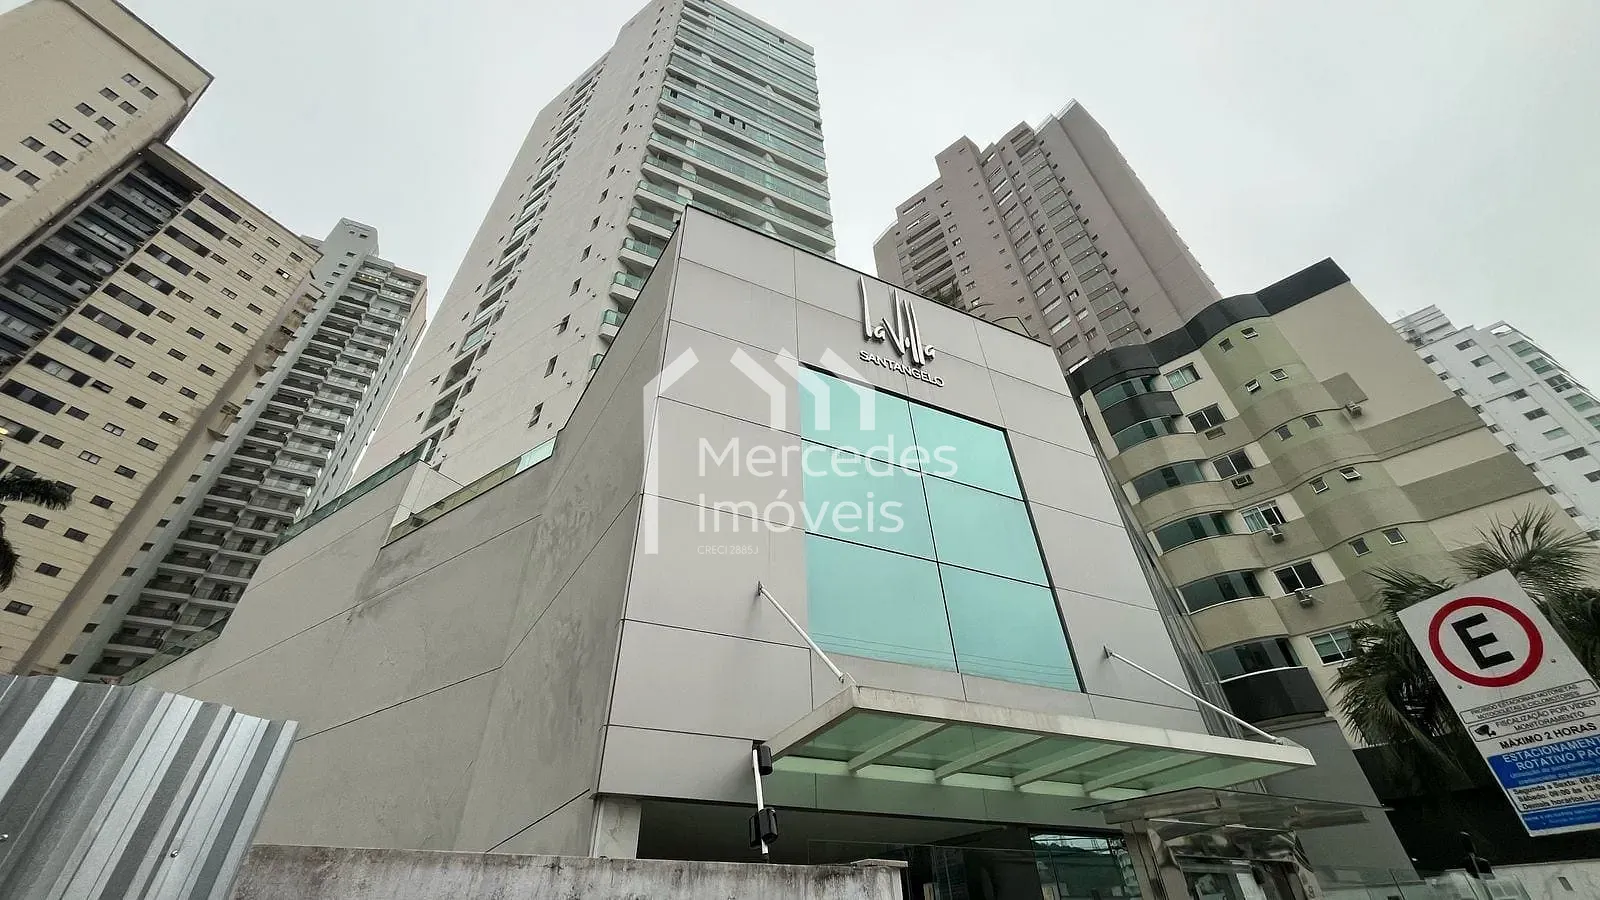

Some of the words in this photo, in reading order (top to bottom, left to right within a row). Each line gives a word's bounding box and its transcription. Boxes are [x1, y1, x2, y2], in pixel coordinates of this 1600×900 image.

[857, 349, 945, 387] SANTANGELO
[1451, 612, 1515, 670] E
[1550, 703, 1571, 716] POR
[1513, 711, 1585, 731] MONITORAMENTO
[1544, 732, 1554, 740] 2
[1554, 722, 1598, 738] HORAS
[1516, 752, 1576, 771] ROTATIVO
